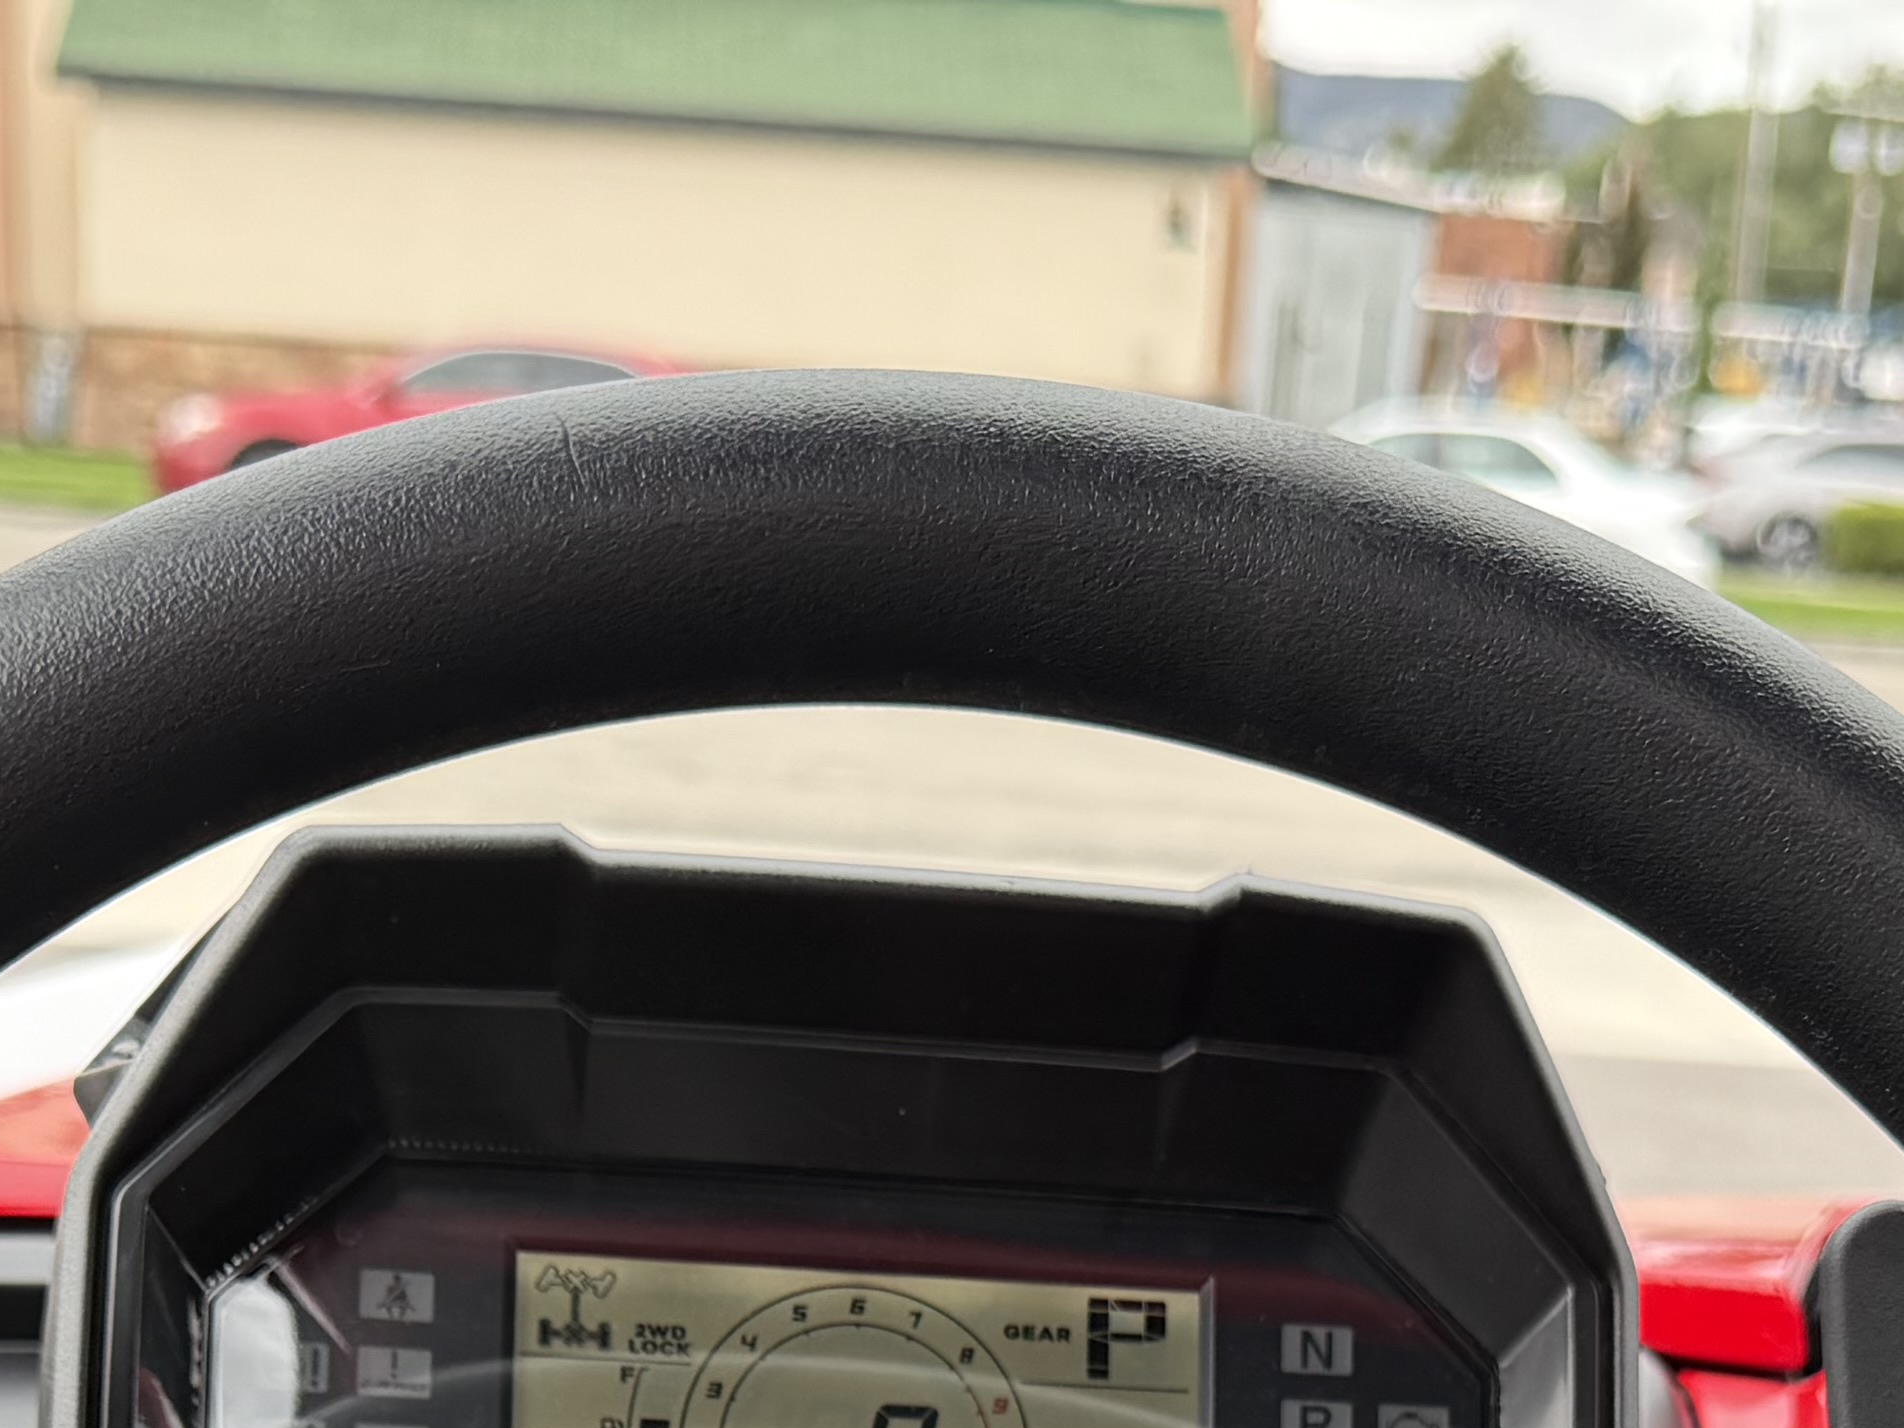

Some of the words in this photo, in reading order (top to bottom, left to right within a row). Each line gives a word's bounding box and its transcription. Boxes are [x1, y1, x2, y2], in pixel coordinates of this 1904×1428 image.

[792, 1304, 809, 1323] 5
[849, 1297, 867, 1316] 6
[908, 1310, 924, 1329] 7
[634, 1323, 688, 1341] 2WD
[1003, 1323, 1072, 1344] GEAR
[1086, 1297, 1167, 1380] P
[628, 1339, 692, 1357] LOCK
[740, 1334, 759, 1353] 4
[1300, 1330, 1333, 1371] N
[959, 1347, 976, 1366] 8
[620, 1366, 635, 1383] F
[706, 1381, 723, 1400] 3
[992, 1397, 1009, 1415] 9
